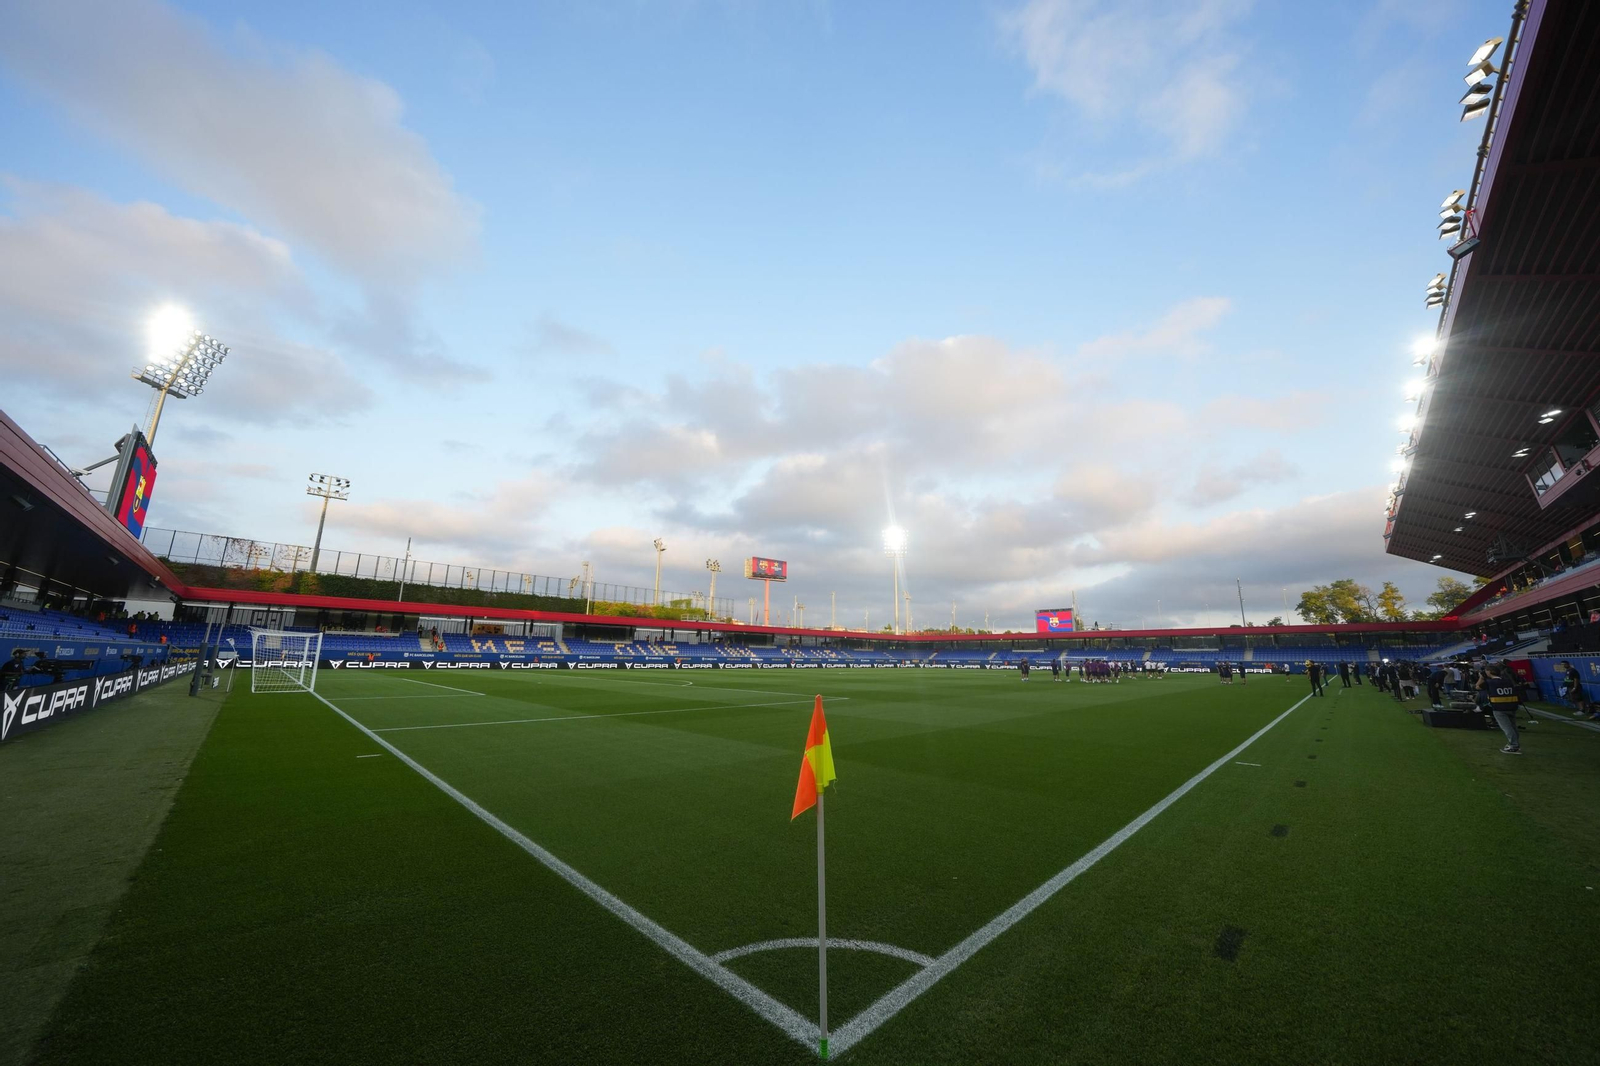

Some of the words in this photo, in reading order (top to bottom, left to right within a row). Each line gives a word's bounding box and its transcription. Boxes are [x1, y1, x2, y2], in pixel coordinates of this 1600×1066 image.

[101, 675, 133, 700] CUPRA
[140, 669, 159, 687] CUPRA
[1496, 687, 1513, 695] 007
[21, 685, 88, 725] CUPRA
